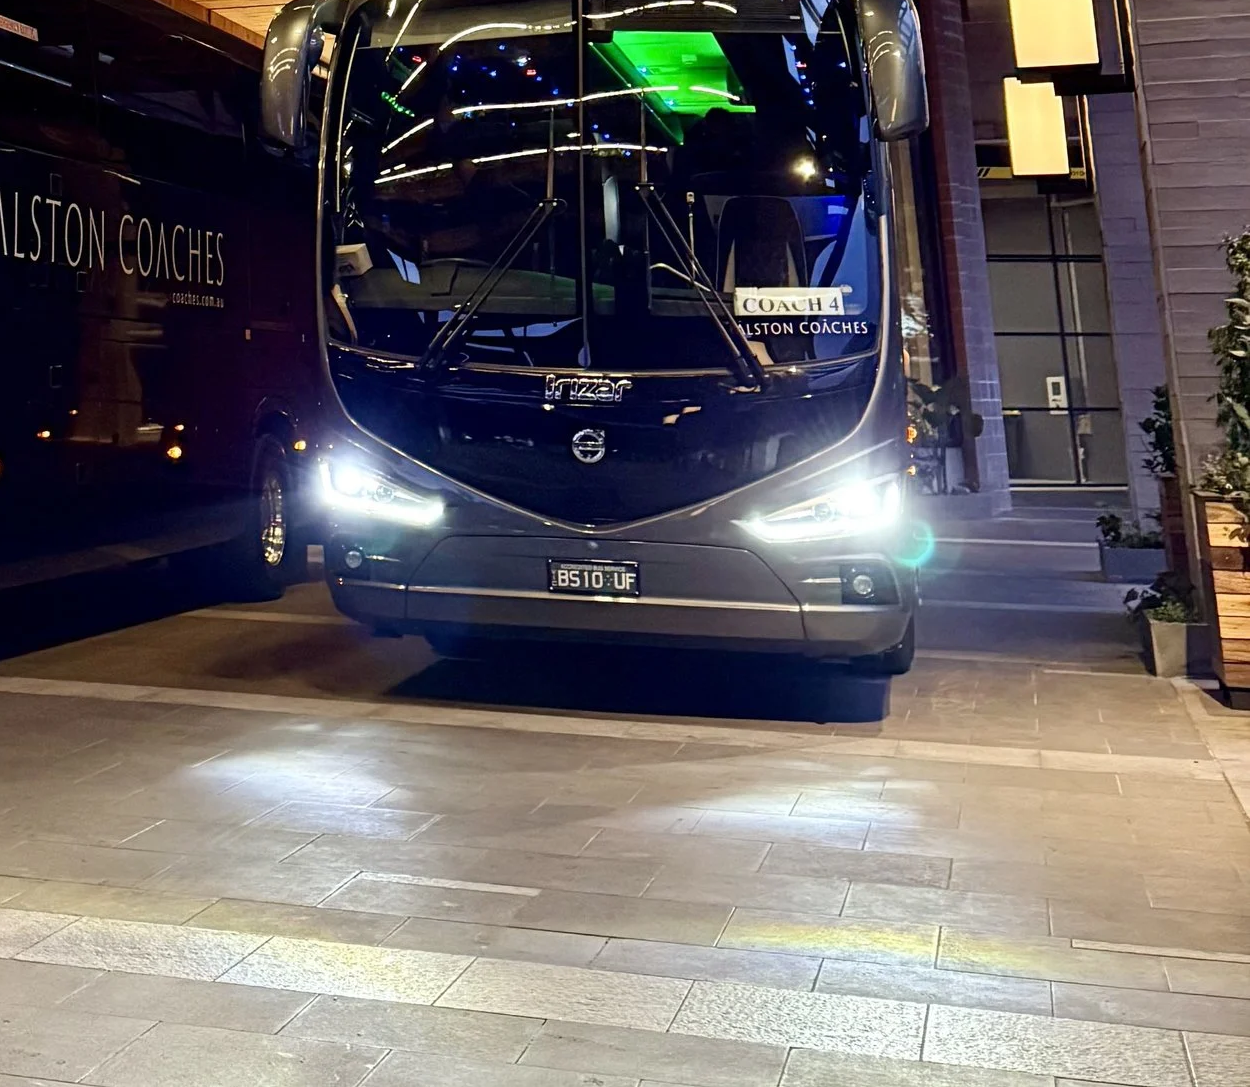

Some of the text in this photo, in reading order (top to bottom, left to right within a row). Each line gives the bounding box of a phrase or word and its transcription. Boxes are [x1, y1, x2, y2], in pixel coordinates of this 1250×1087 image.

[119, 214, 224, 286] COACHES
[743, 297, 839, 313] COACH 4
[799, 318, 868, 335] COACHES
[558, 570, 636, 590] BS10 UF
